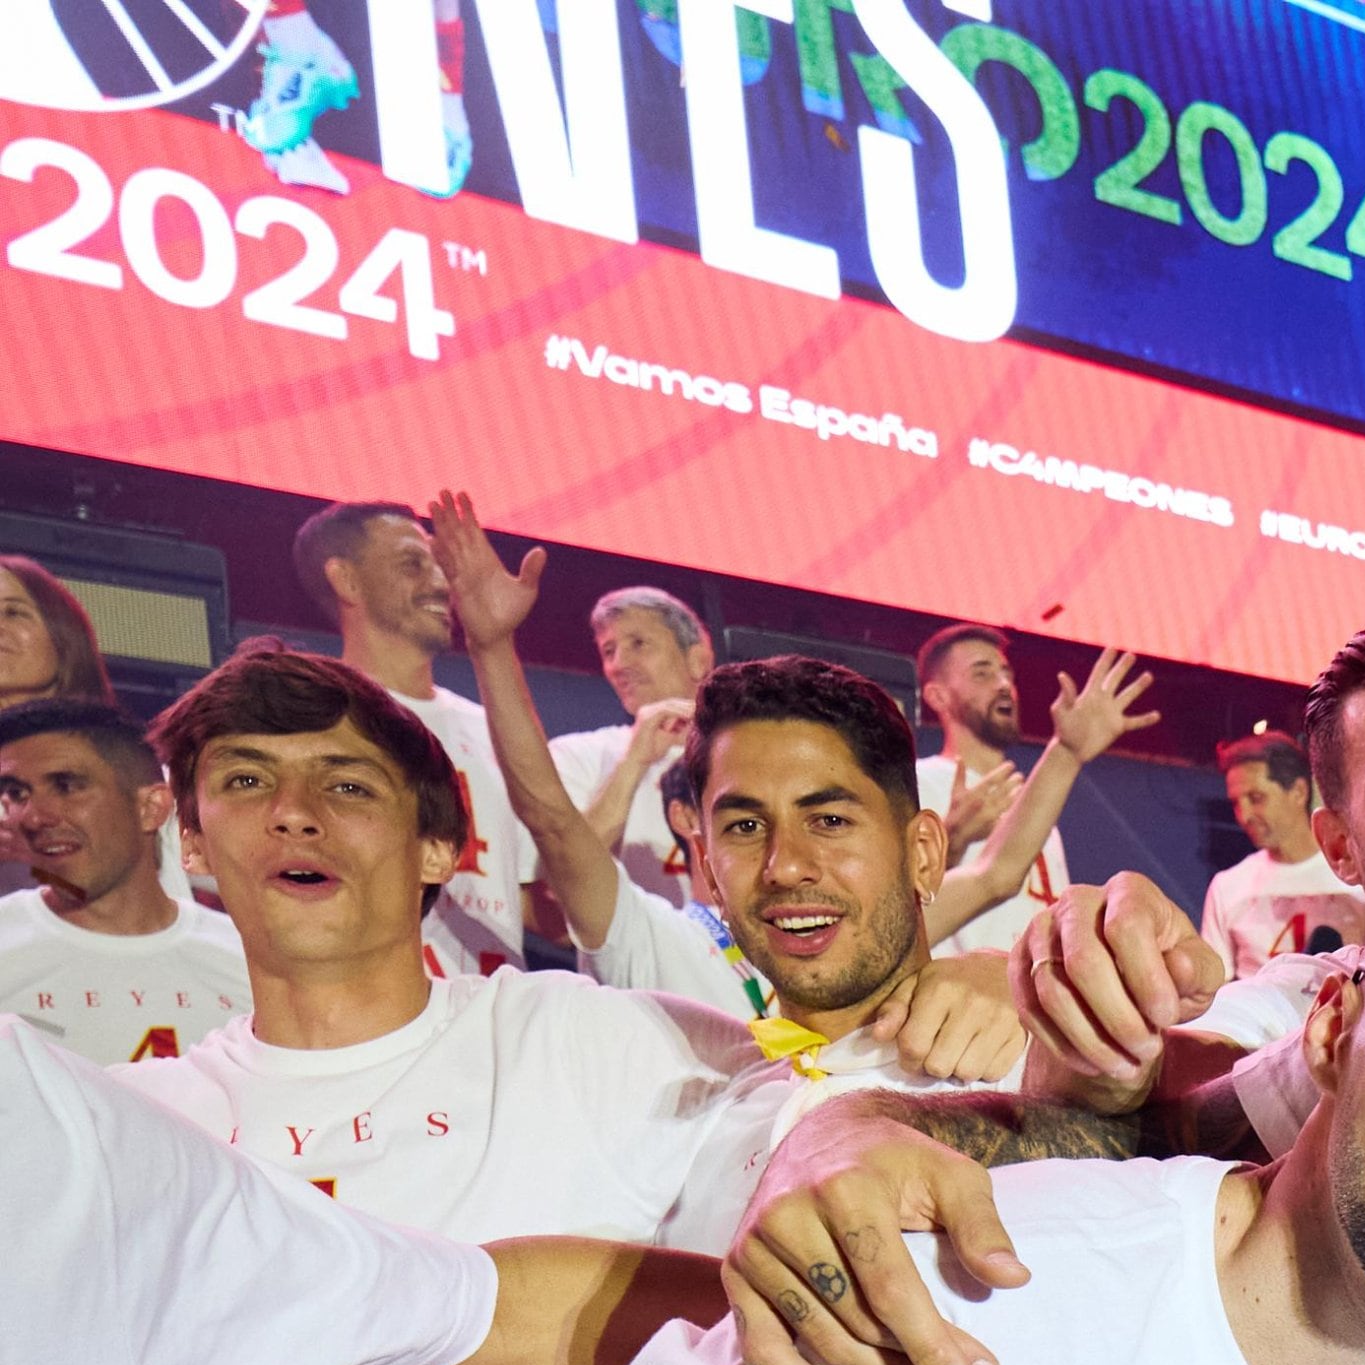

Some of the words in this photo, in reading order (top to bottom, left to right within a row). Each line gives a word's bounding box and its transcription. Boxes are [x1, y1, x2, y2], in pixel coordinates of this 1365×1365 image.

[0, 137, 455, 360] 2024
[443, 240, 488, 276] TM
[543, 334, 752, 414] #Vamos
[759, 383, 939, 458] España
[37, 990, 234, 1010] REYES
